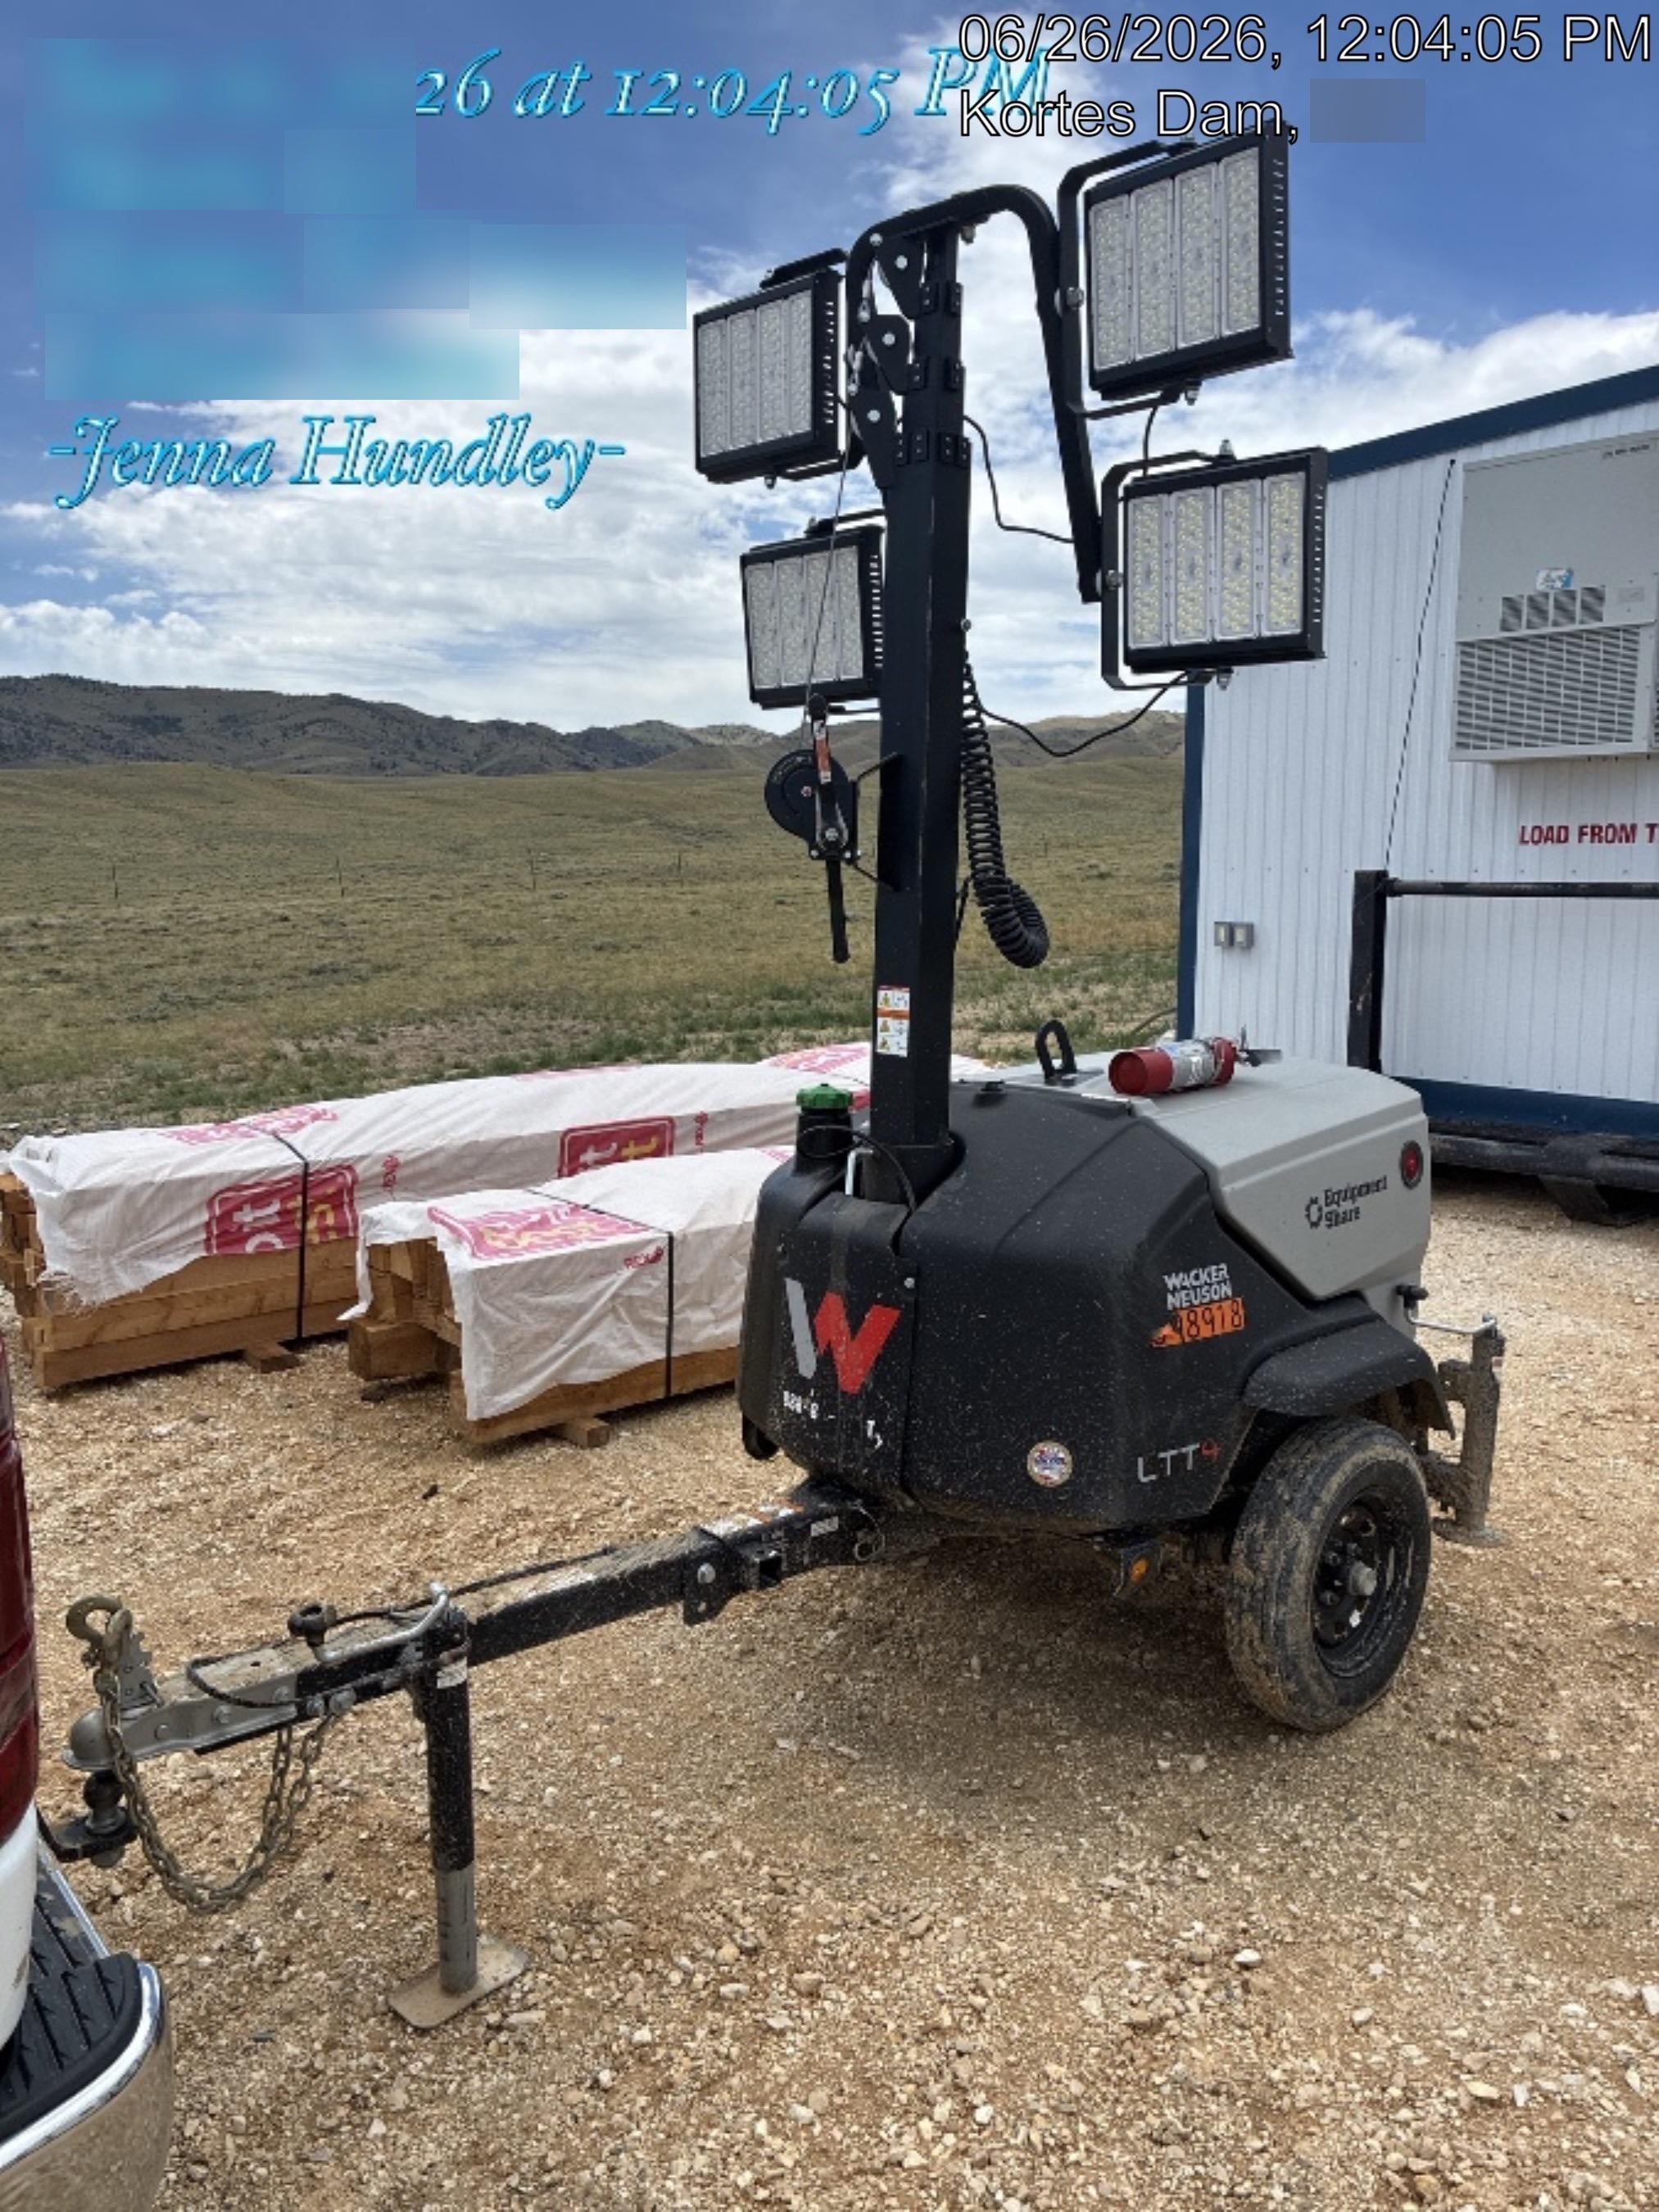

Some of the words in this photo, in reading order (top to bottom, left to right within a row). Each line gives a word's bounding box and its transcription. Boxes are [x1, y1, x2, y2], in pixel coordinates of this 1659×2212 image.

[1519, 825, 1569, 845] LOAD
[1578, 823, 1638, 844] FROM
[1324, 1175, 1387, 1207] Equipment
[1324, 1206, 1360, 1229] Share
[1163, 1262, 1230, 1291] WACKER
[1167, 1281, 1232, 1311] NEUSON
